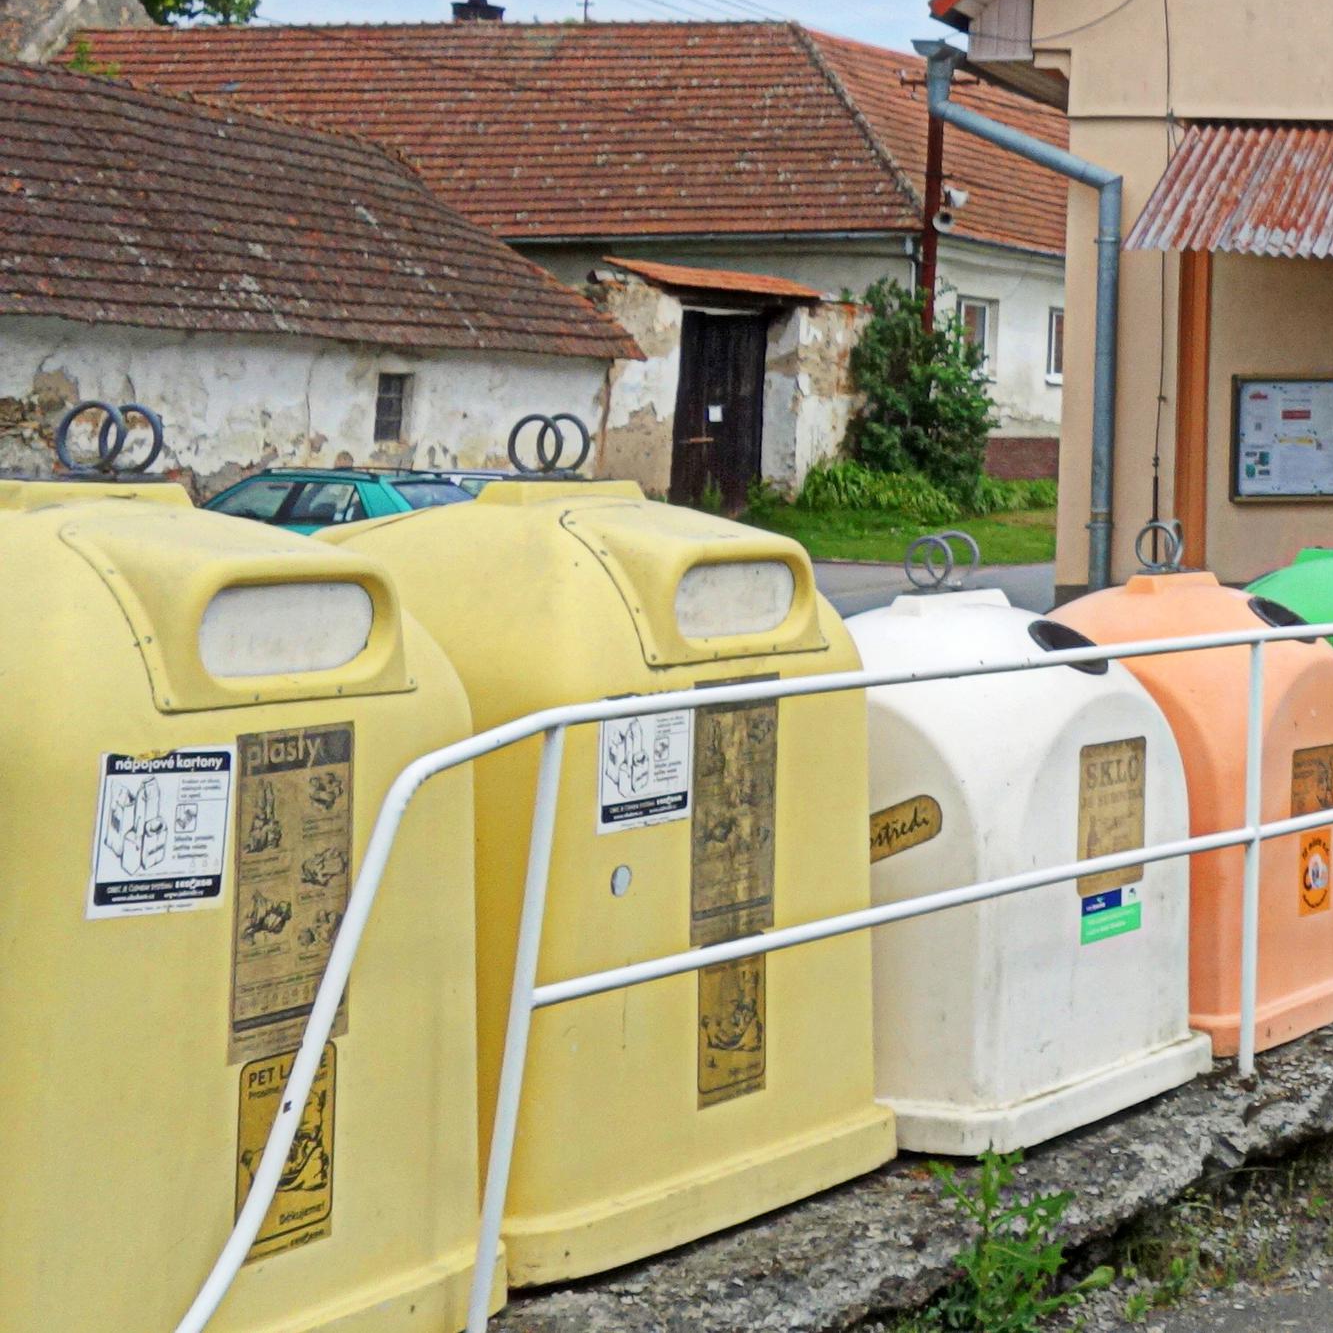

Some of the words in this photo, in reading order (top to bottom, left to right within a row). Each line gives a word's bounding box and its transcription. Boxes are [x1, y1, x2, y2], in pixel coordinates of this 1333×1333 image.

[246, 728, 321, 776] plasty
[115, 756, 174, 773] nápojové
[176, 756, 223, 770] kartony
[249, 1067, 275, 1088] PET
